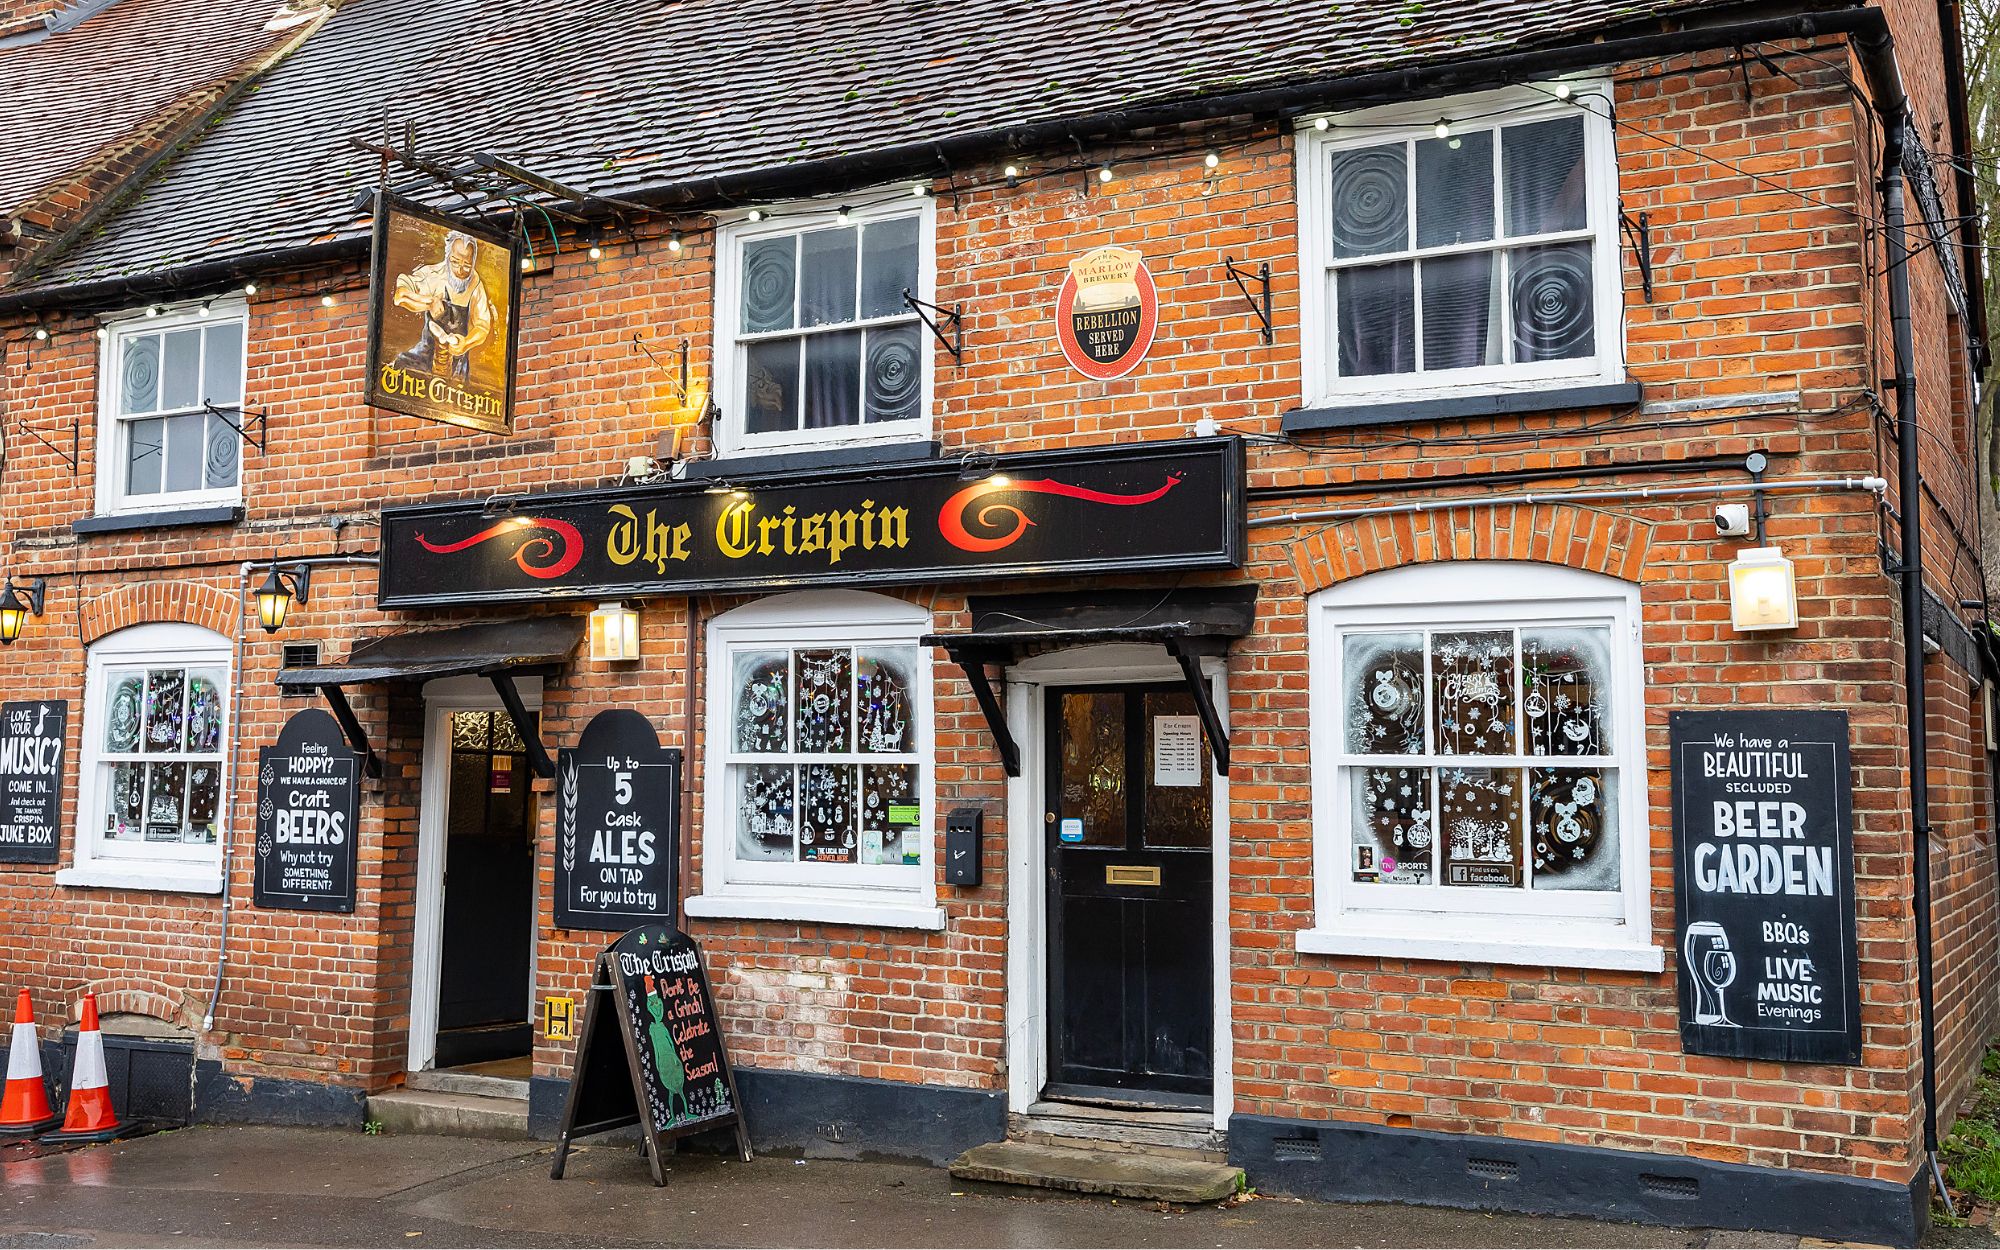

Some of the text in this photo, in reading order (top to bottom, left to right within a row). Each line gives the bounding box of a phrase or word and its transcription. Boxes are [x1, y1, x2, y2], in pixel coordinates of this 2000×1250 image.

[1078, 262, 1134, 276] MARLOW
[1084, 272, 1128, 284] BREWERY
[1076, 310, 1137, 331] REBELLION
[1088, 330, 1124, 344] SERVED
[1094, 343, 1120, 357] HERE
[382, 363, 502, 416] The Crispin
[607, 498, 910, 574] The Crispin
[10, 710, 32, 722] LOVE
[10, 722, 31, 735] YOUR
[302, 742, 328, 755] Feeling
[1714, 732, 1788, 748] We have a
[0, 736, 62, 776] MUSIC?
[289, 756, 334, 774] HOPPY?
[607, 756, 639, 772] Up to
[1703, 751, 1808, 778] BEAUTIFUL
[8, 780, 52, 793] COME IN...
[280, 776, 347, 786] WE HAVE A CHOICE OF
[615, 772, 632, 805] 5
[1726, 782, 1792, 794] SECLUDED
[21, 797, 35, 806] check
[37, 798, 46, 806] out
[288, 790, 330, 808] Craft
[14, 815, 44, 824] CRISPIN
[276, 809, 345, 845] BEERS
[605, 810, 641, 827] Cask
[1713, 801, 1807, 839] BEER
[0, 824, 53, 844] JUKE BOX
[589, 830, 656, 866] ALES
[280, 850, 334, 867] Why not try
[284, 868, 329, 879] SOMETHING
[600, 868, 643, 885] ON TAP
[1694, 842, 1834, 896] GARDEN
[282, 878, 332, 890] DIFFERENT?
[1470, 874, 1510, 883] facebook
[580, 886, 656, 910] For you to try
[1762, 921, 1810, 944] BBQ's
[620, 947, 698, 976] The Crispin
[1765, 956, 1812, 982] LIVE
[687, 978, 700, 996] Be
[1757, 983, 1822, 1004] MUSIC
[668, 994, 704, 1020] a Grinch!
[1757, 1003, 1822, 1023] Evenings
[553, 1026, 564, 1034] 24
[680, 1044, 694, 1062] the
[685, 1051, 718, 1081] Season!
